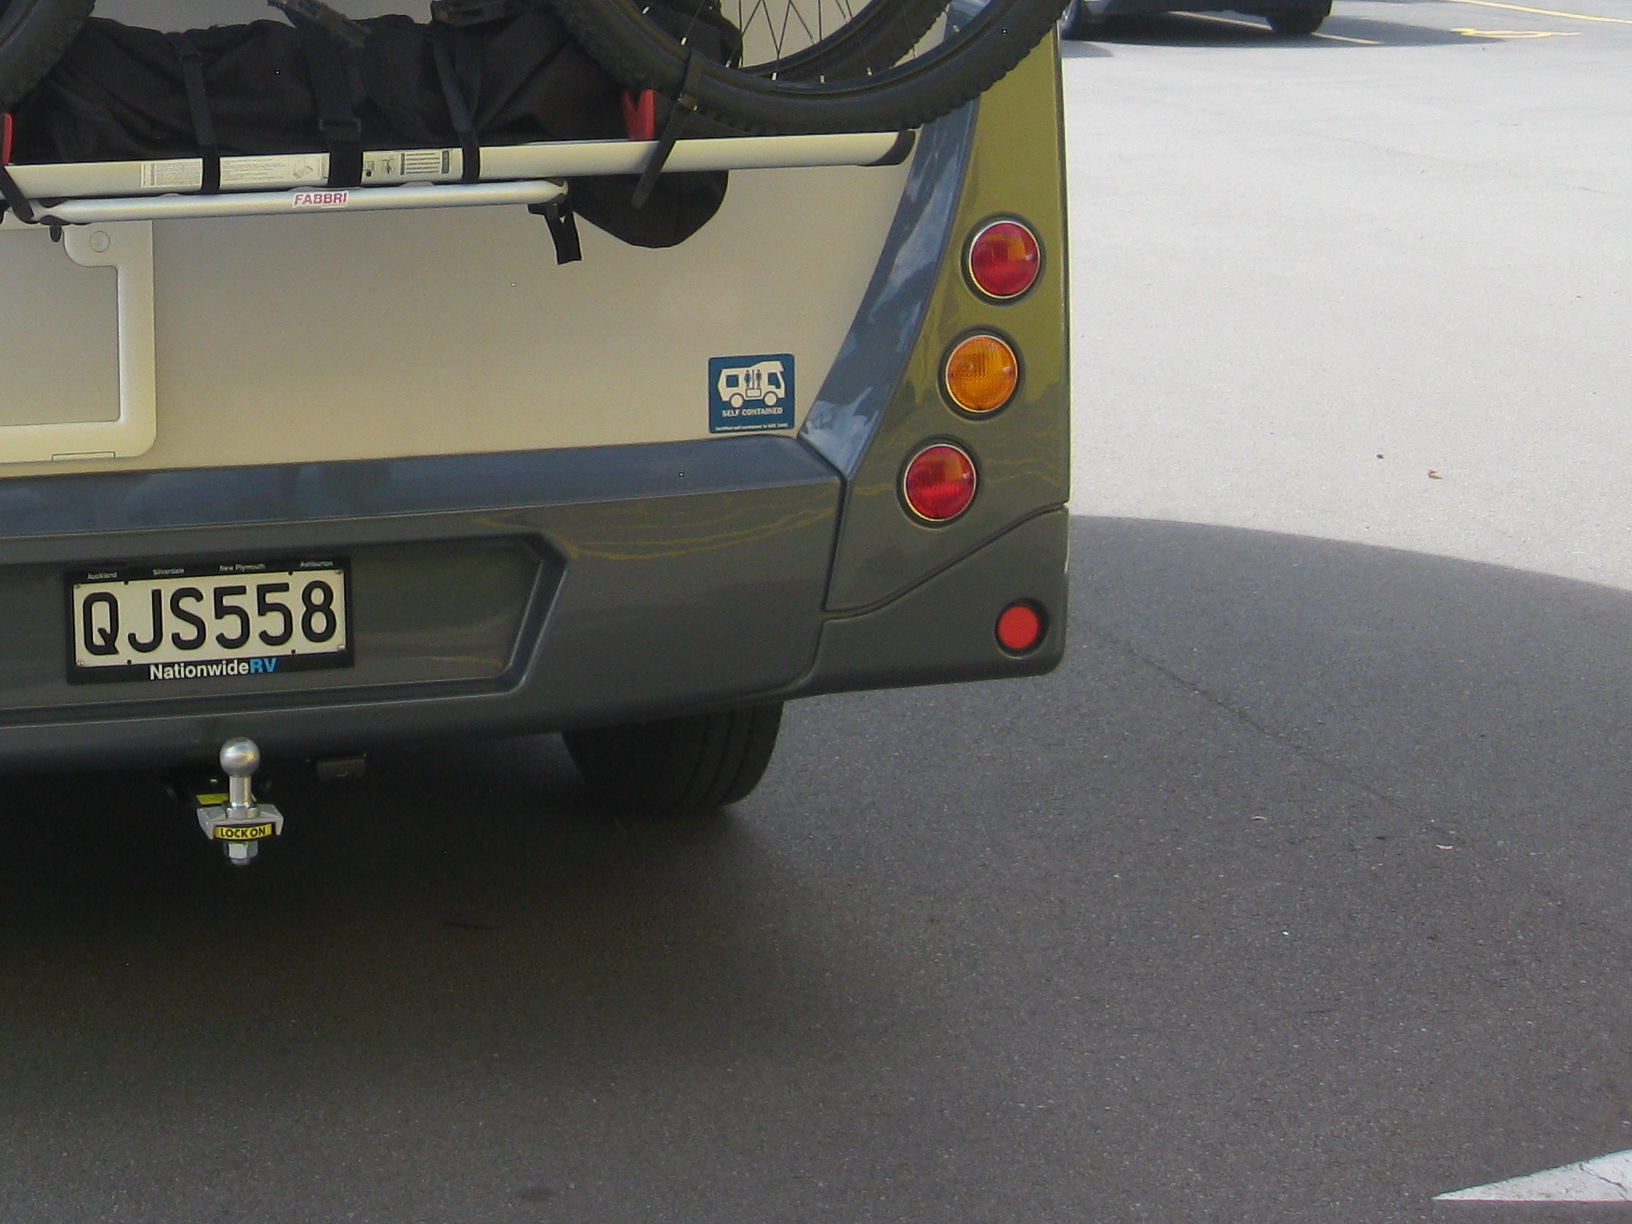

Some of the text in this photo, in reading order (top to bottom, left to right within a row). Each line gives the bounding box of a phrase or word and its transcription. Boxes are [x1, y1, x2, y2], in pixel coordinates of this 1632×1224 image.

[294, 193, 347, 205] FABBRI
[722, 407, 783, 417] SELF CONTAINED
[82, 580, 337, 656] QJS558
[220, 826, 266, 838] LOCK ON
